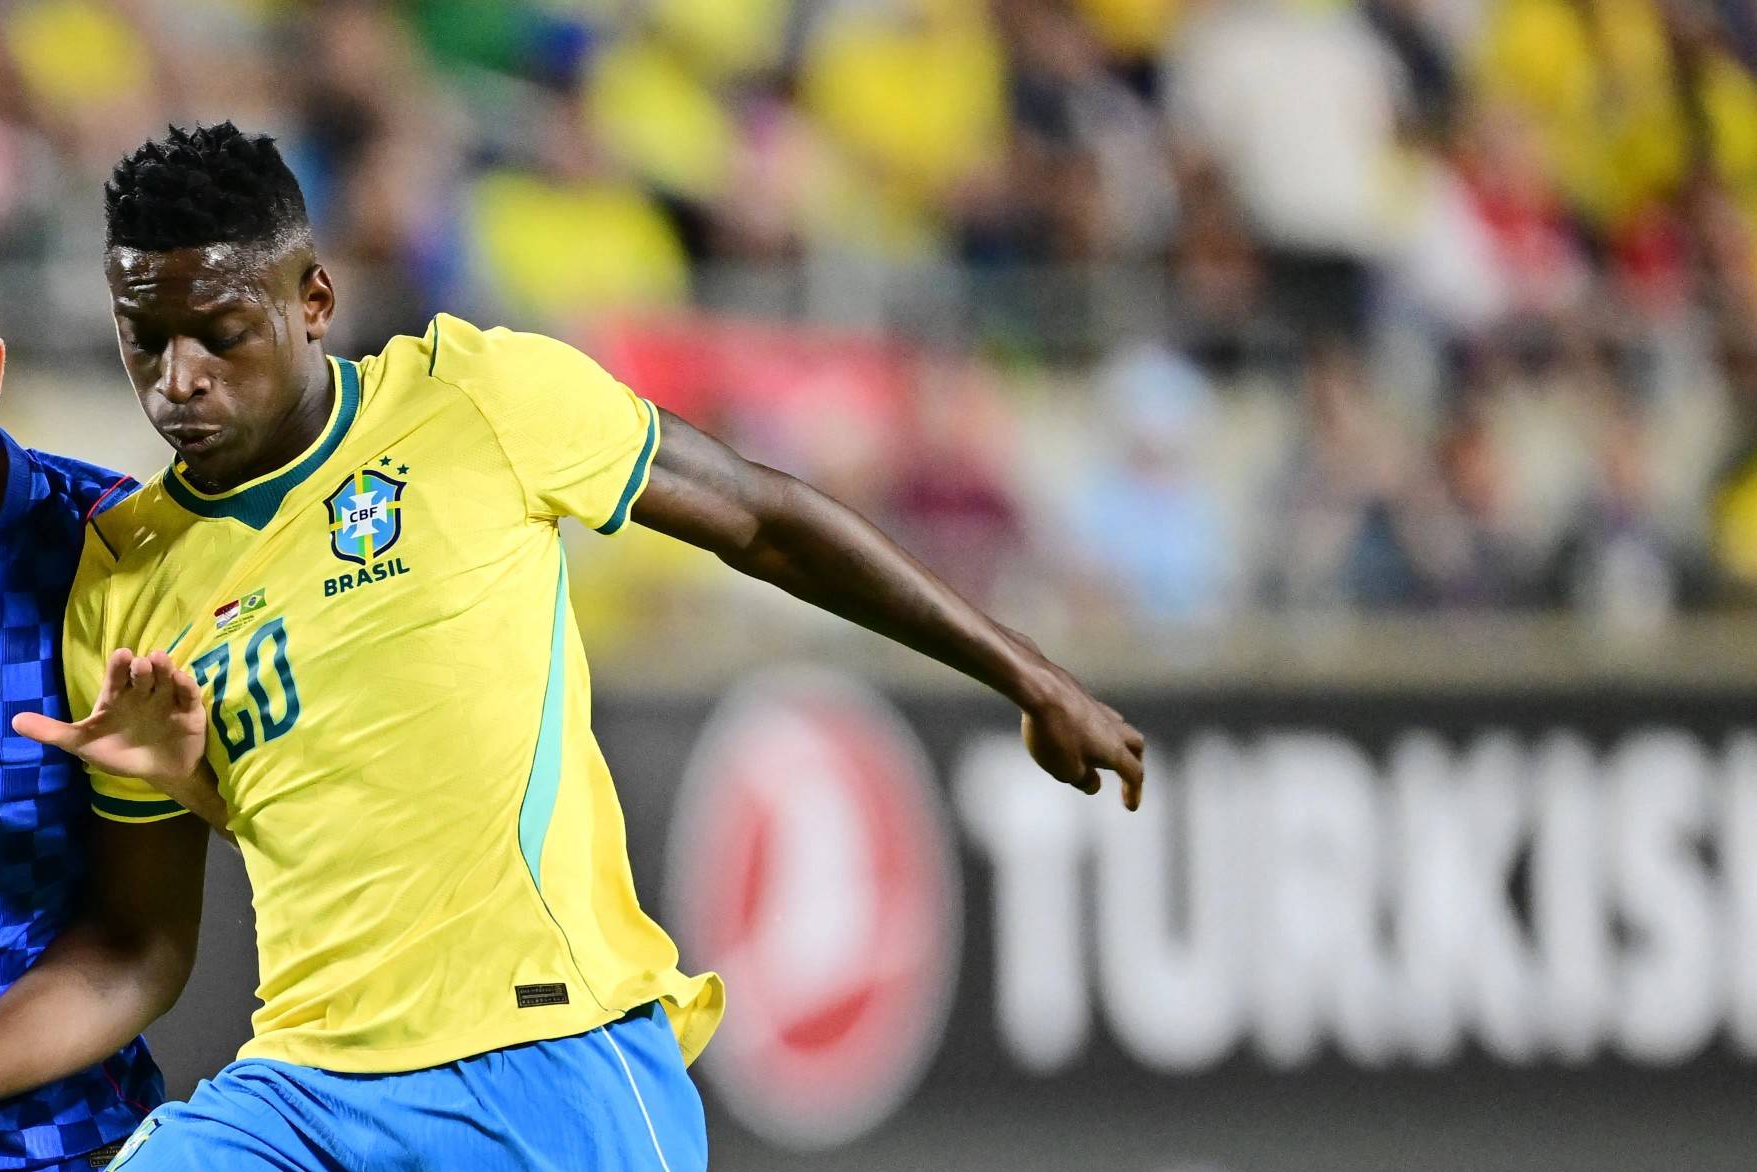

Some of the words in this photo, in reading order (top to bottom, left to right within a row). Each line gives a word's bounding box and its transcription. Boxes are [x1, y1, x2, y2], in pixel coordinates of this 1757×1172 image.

[349, 506, 378, 523] CBF
[324, 558, 410, 597] BRASIL
[191, 617, 302, 764] 20
[953, 728, 1757, 1072] TURKIS
